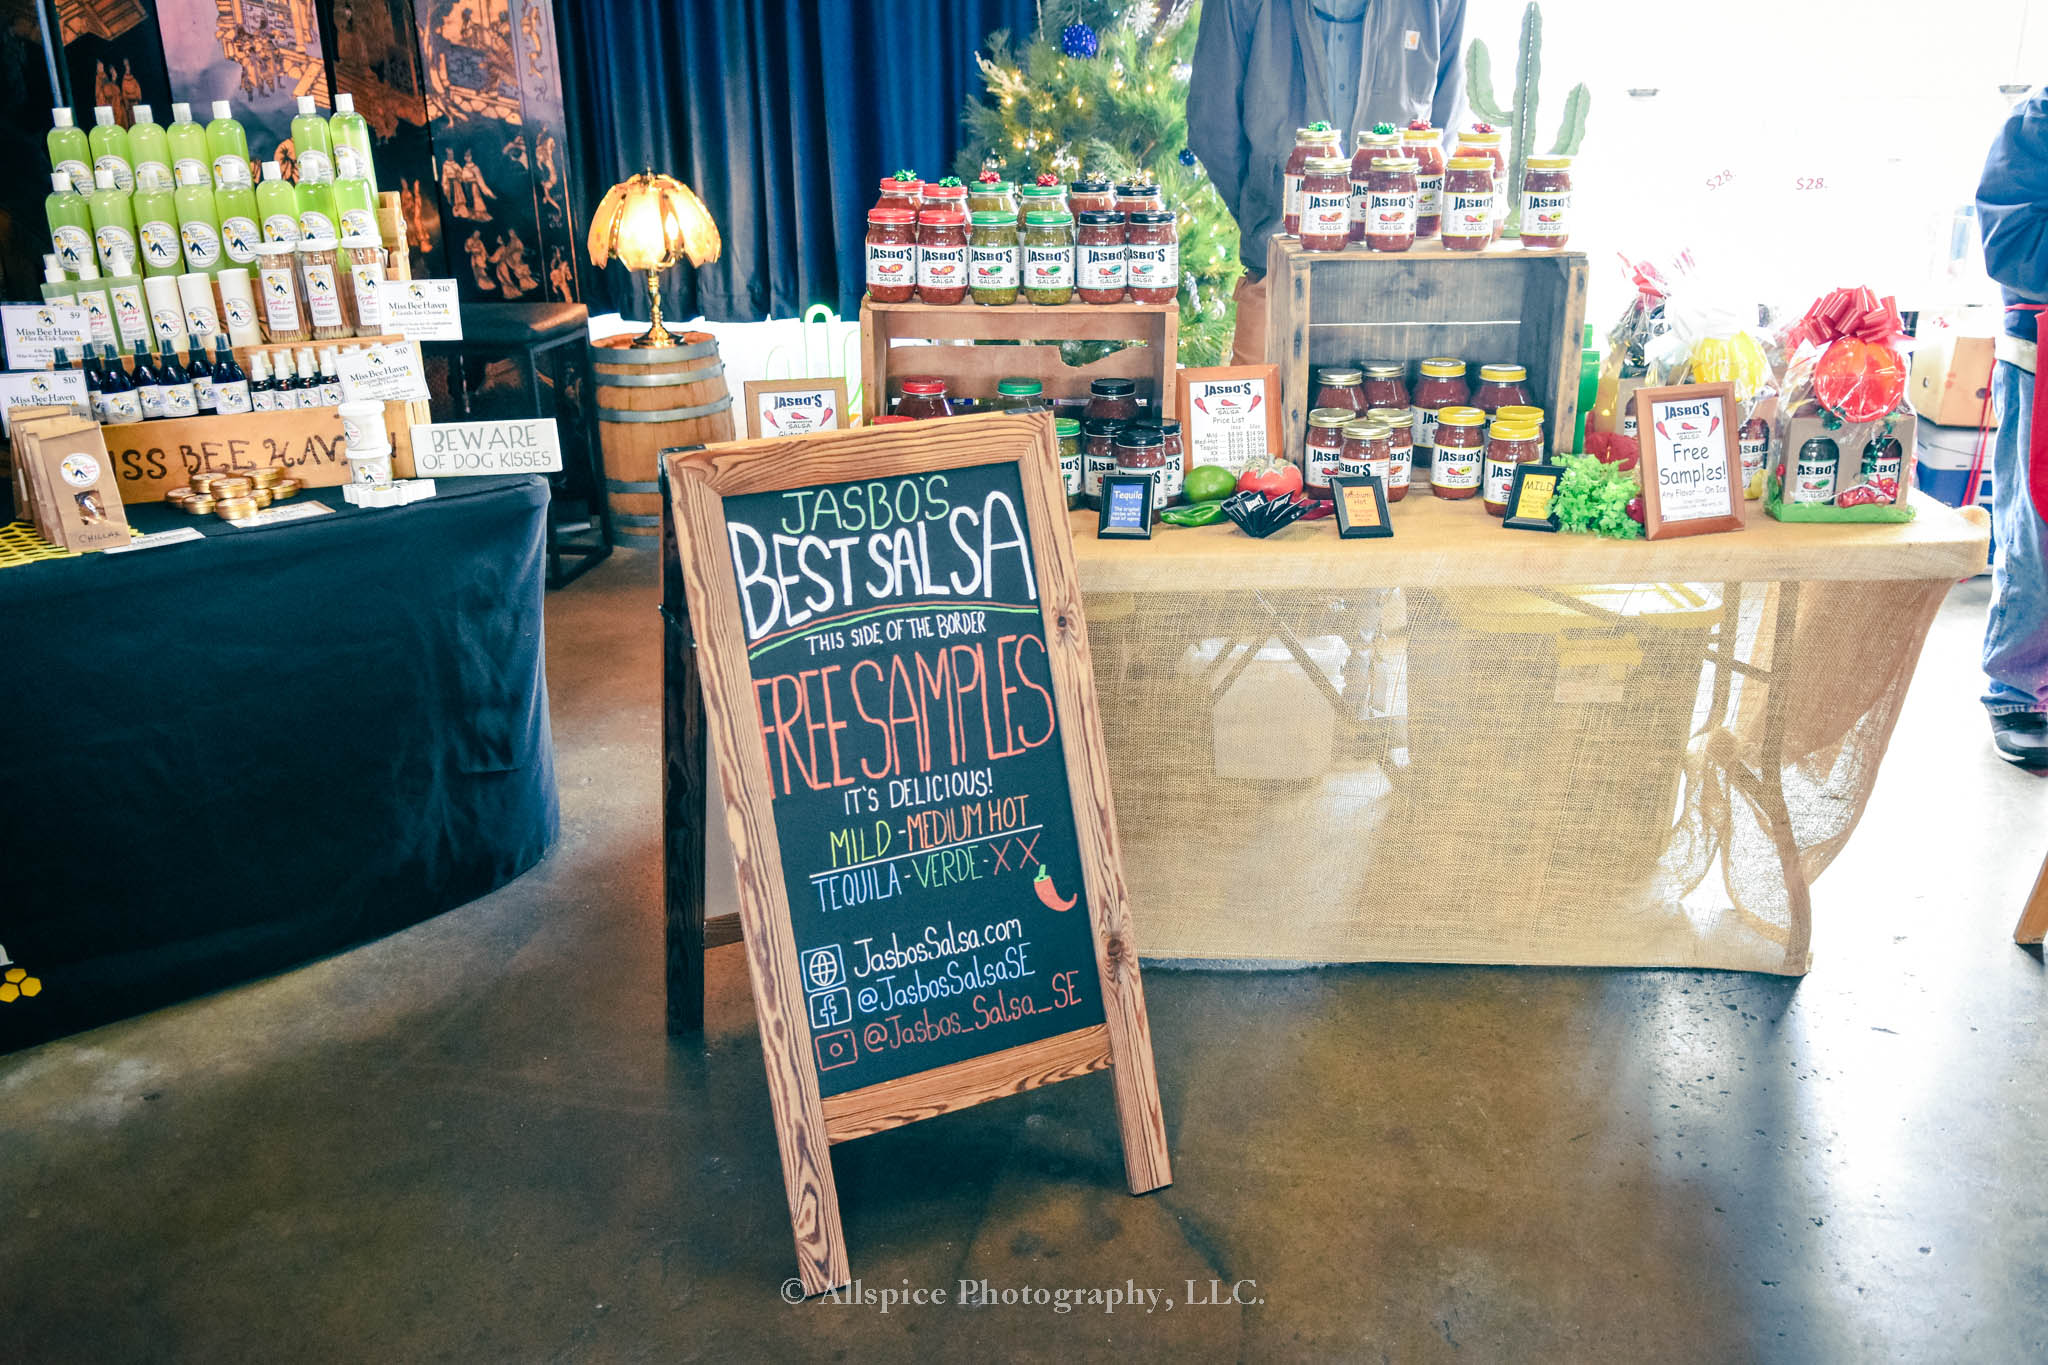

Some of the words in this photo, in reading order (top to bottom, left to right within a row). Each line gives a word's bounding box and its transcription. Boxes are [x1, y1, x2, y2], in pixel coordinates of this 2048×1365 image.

[1309, 195, 1350, 209] JASBO'S
[1371, 195, 1414, 208] JASBO'S
[870, 246, 912, 261] JASBO'S
[922, 248, 963, 263] JASBO'S
[971, 249, 1012, 263] JASBO'S
[1028, 249, 1069, 263] JASBO'S
[388, 302, 407, 310] Miss
[423, 301, 448, 309] Haven
[16, 328, 35, 336] Miss
[37, 328, 52, 336] Bee
[54, 328, 80, 336] Haven
[63, 376, 77, 384] $10
[350, 373, 368, 382] Miss
[368, 370, 382, 378] Bee
[384, 364, 409, 374] Haven
[10, 396, 31, 404] Miss
[31, 394, 48, 402] Bee
[48, 393, 76, 402] Haven
[1205, 383, 1251, 397] JASBO'S
[774, 394, 822, 409] JASBO'S
[1665, 402, 1710, 420] JASBO'S
[432, 424, 536, 453] BEWARE
[180, 440, 255, 476] BEE
[423, 454, 446, 469] OF
[454, 453, 493, 469] DOG
[500, 451, 551, 467] KISSES
[1439, 449, 1481, 463] JASBO'S
[1673, 443, 1709, 462] Free
[1660, 460, 1726, 488] Samples!
[1525, 481, 1553, 491] MILD
[782, 475, 949, 534] JASBO'S
[1113, 491, 1142, 500] Tequila
[728, 521, 860, 640] BEST
[867, 490, 1037, 600] SALSA
[805, 634, 845, 656] THIS
[851, 628, 881, 649] SIDE
[886, 619, 907, 641] OF
[906, 616, 934, 639] THE
[937, 611, 986, 638] BORDER
[752, 665, 856, 800] FREE
[850, 634, 1055, 780] SAMPLES
[844, 789, 879, 815] IT'S
[889, 769, 994, 809] DELICIOUS!
[830, 820, 891, 868] MILD
[989, 795, 1029, 833] HOT
[854, 919, 1022, 978] JasbosSalsa.com
[858, 943, 1035, 1013] @JasbosSalsaSE
[864, 971, 1082, 1052] @Jasbos_Salsa_SE
